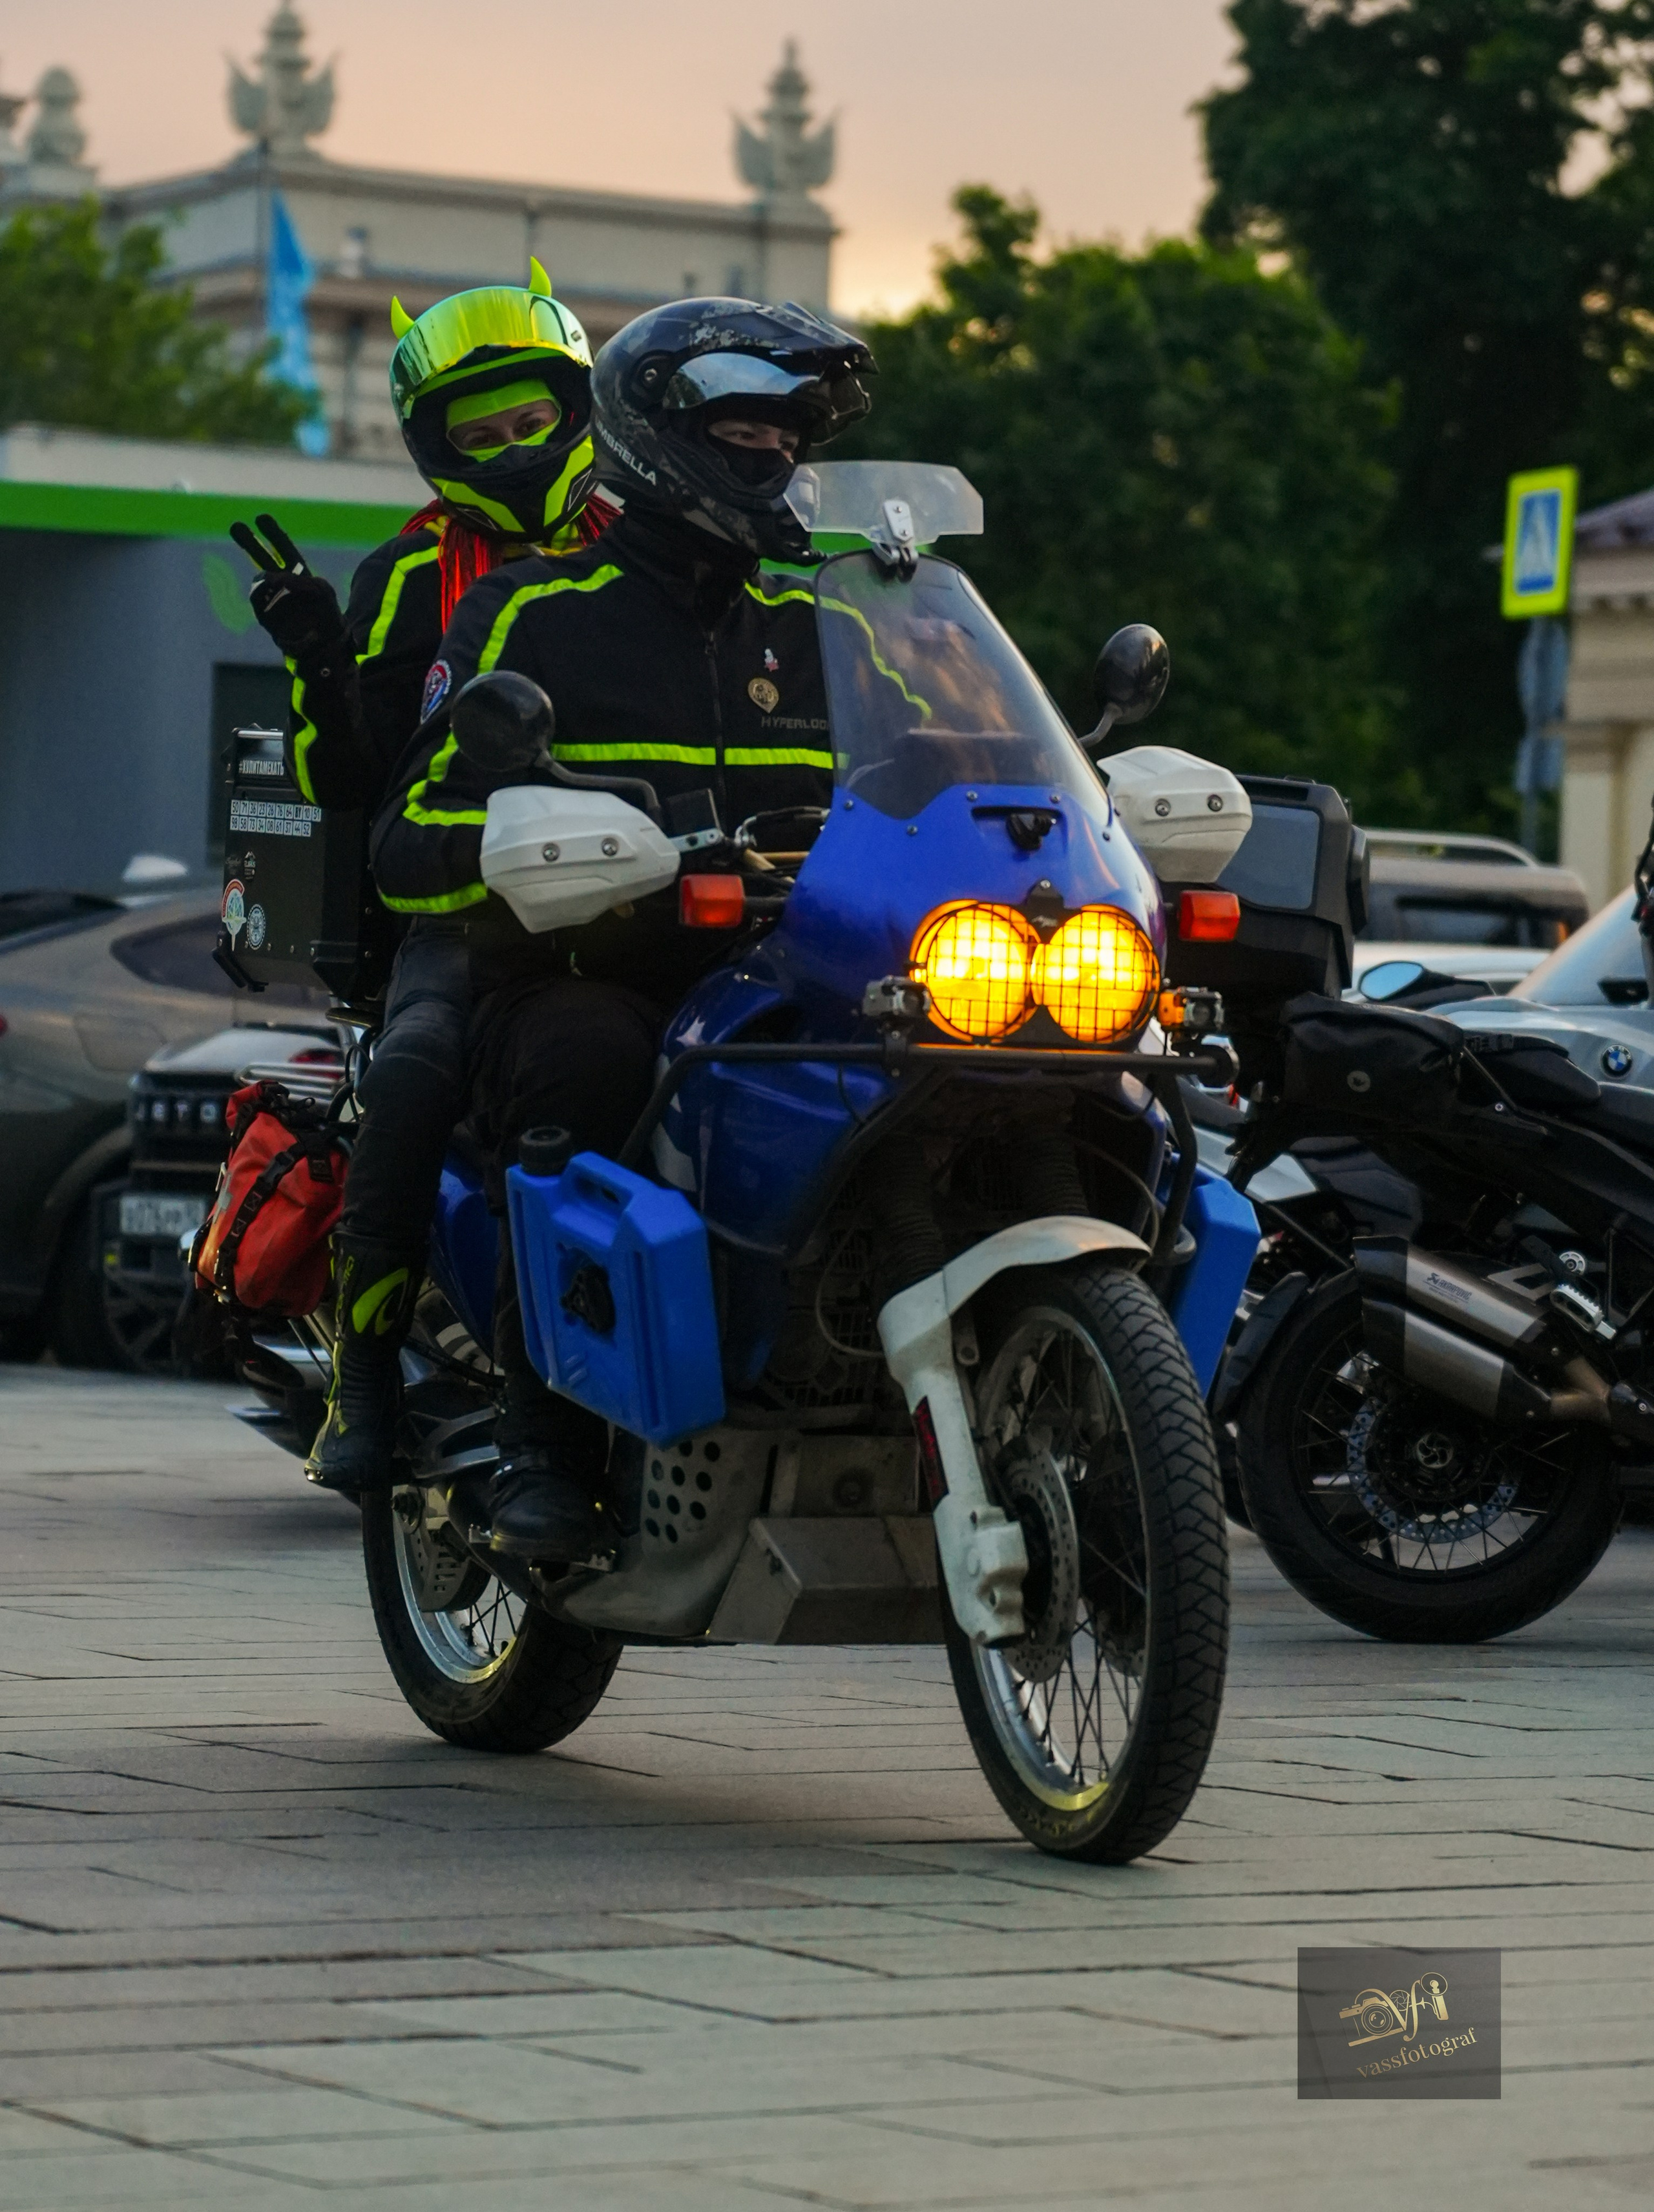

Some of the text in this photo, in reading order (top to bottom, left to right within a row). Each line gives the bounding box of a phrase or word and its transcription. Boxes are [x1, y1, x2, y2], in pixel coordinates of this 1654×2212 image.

[761, 716, 829, 731] HYPERLOO
[233, 802, 238, 813] 50
[242, 803, 247, 813] 71
[260, 804, 265, 815] 23
[277, 805, 282, 816] 76
[287, 806, 292, 817] 64
[305, 808, 309, 818] 10
[314, 808, 319, 819] 51
[232, 817, 238, 828] 98
[249, 819, 255, 830] 73
[277, 821, 282, 832] 61
[286, 822, 291, 832] 37
[304, 824, 309, 835] 52
